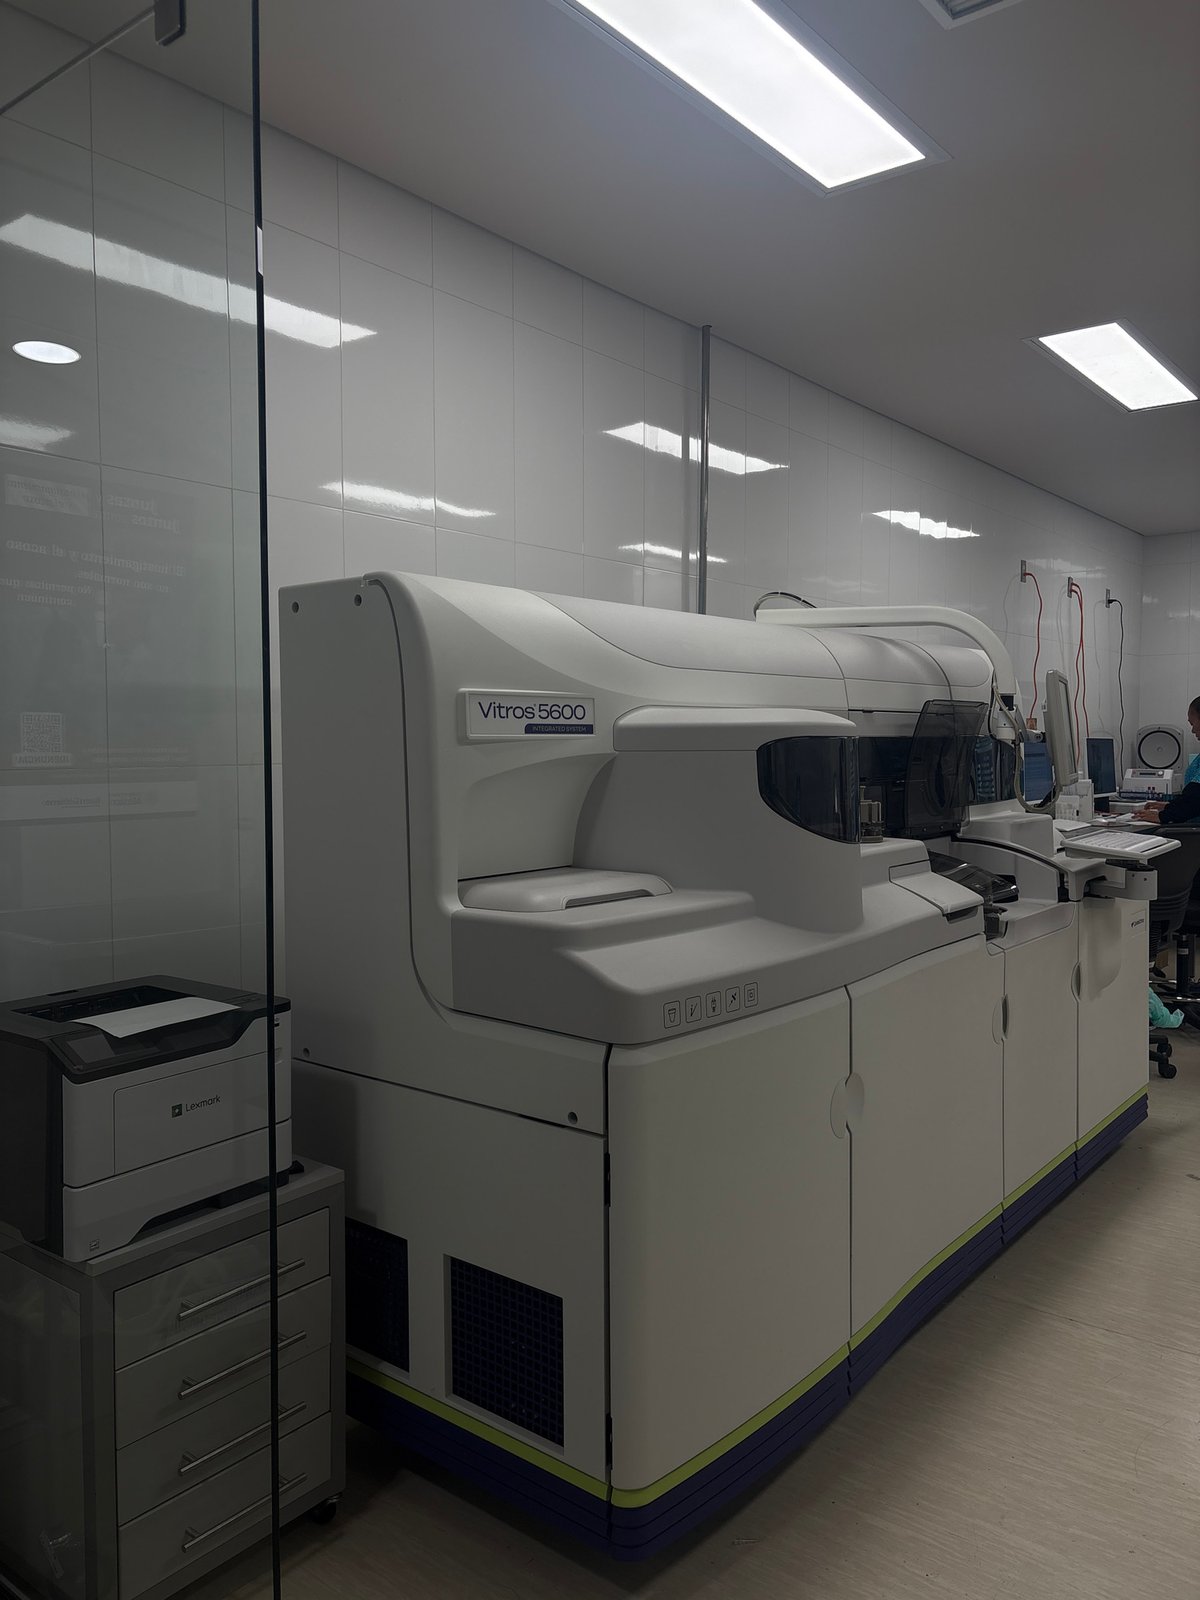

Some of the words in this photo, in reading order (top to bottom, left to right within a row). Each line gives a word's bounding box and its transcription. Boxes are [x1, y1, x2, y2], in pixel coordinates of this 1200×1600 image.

[478, 701, 535, 720] Vitros
[538, 703, 586, 720] 5600
[185, 1094, 221, 1112] Lexmark
